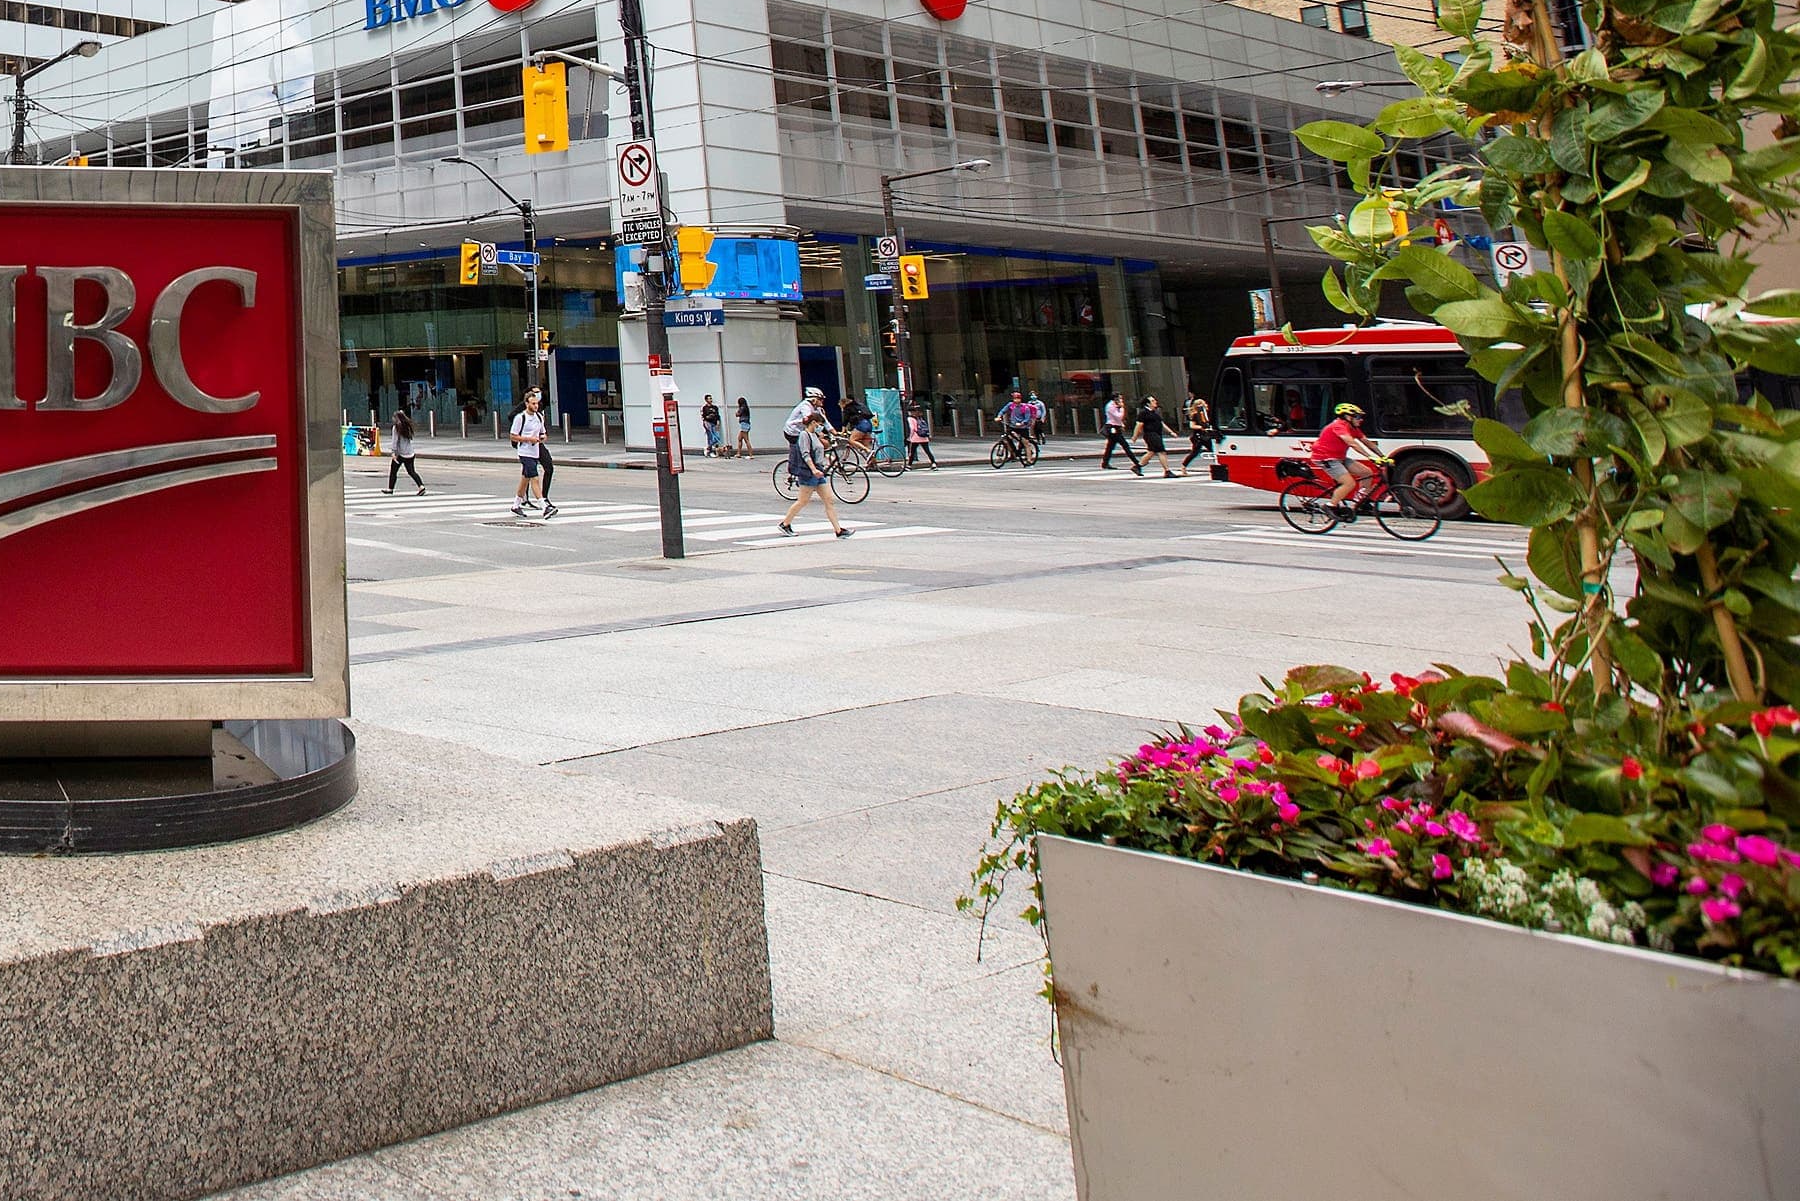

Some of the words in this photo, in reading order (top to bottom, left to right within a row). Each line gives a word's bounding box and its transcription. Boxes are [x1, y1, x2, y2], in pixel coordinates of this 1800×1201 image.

[624, 223, 634, 232] TTC
[635, 220, 661, 231] VEHICLES
[625, 230, 660, 241] EXCEPTED
[509, 252, 522, 262] Bay
[675, 312, 694, 325] King
[696, 313, 703, 322] St
